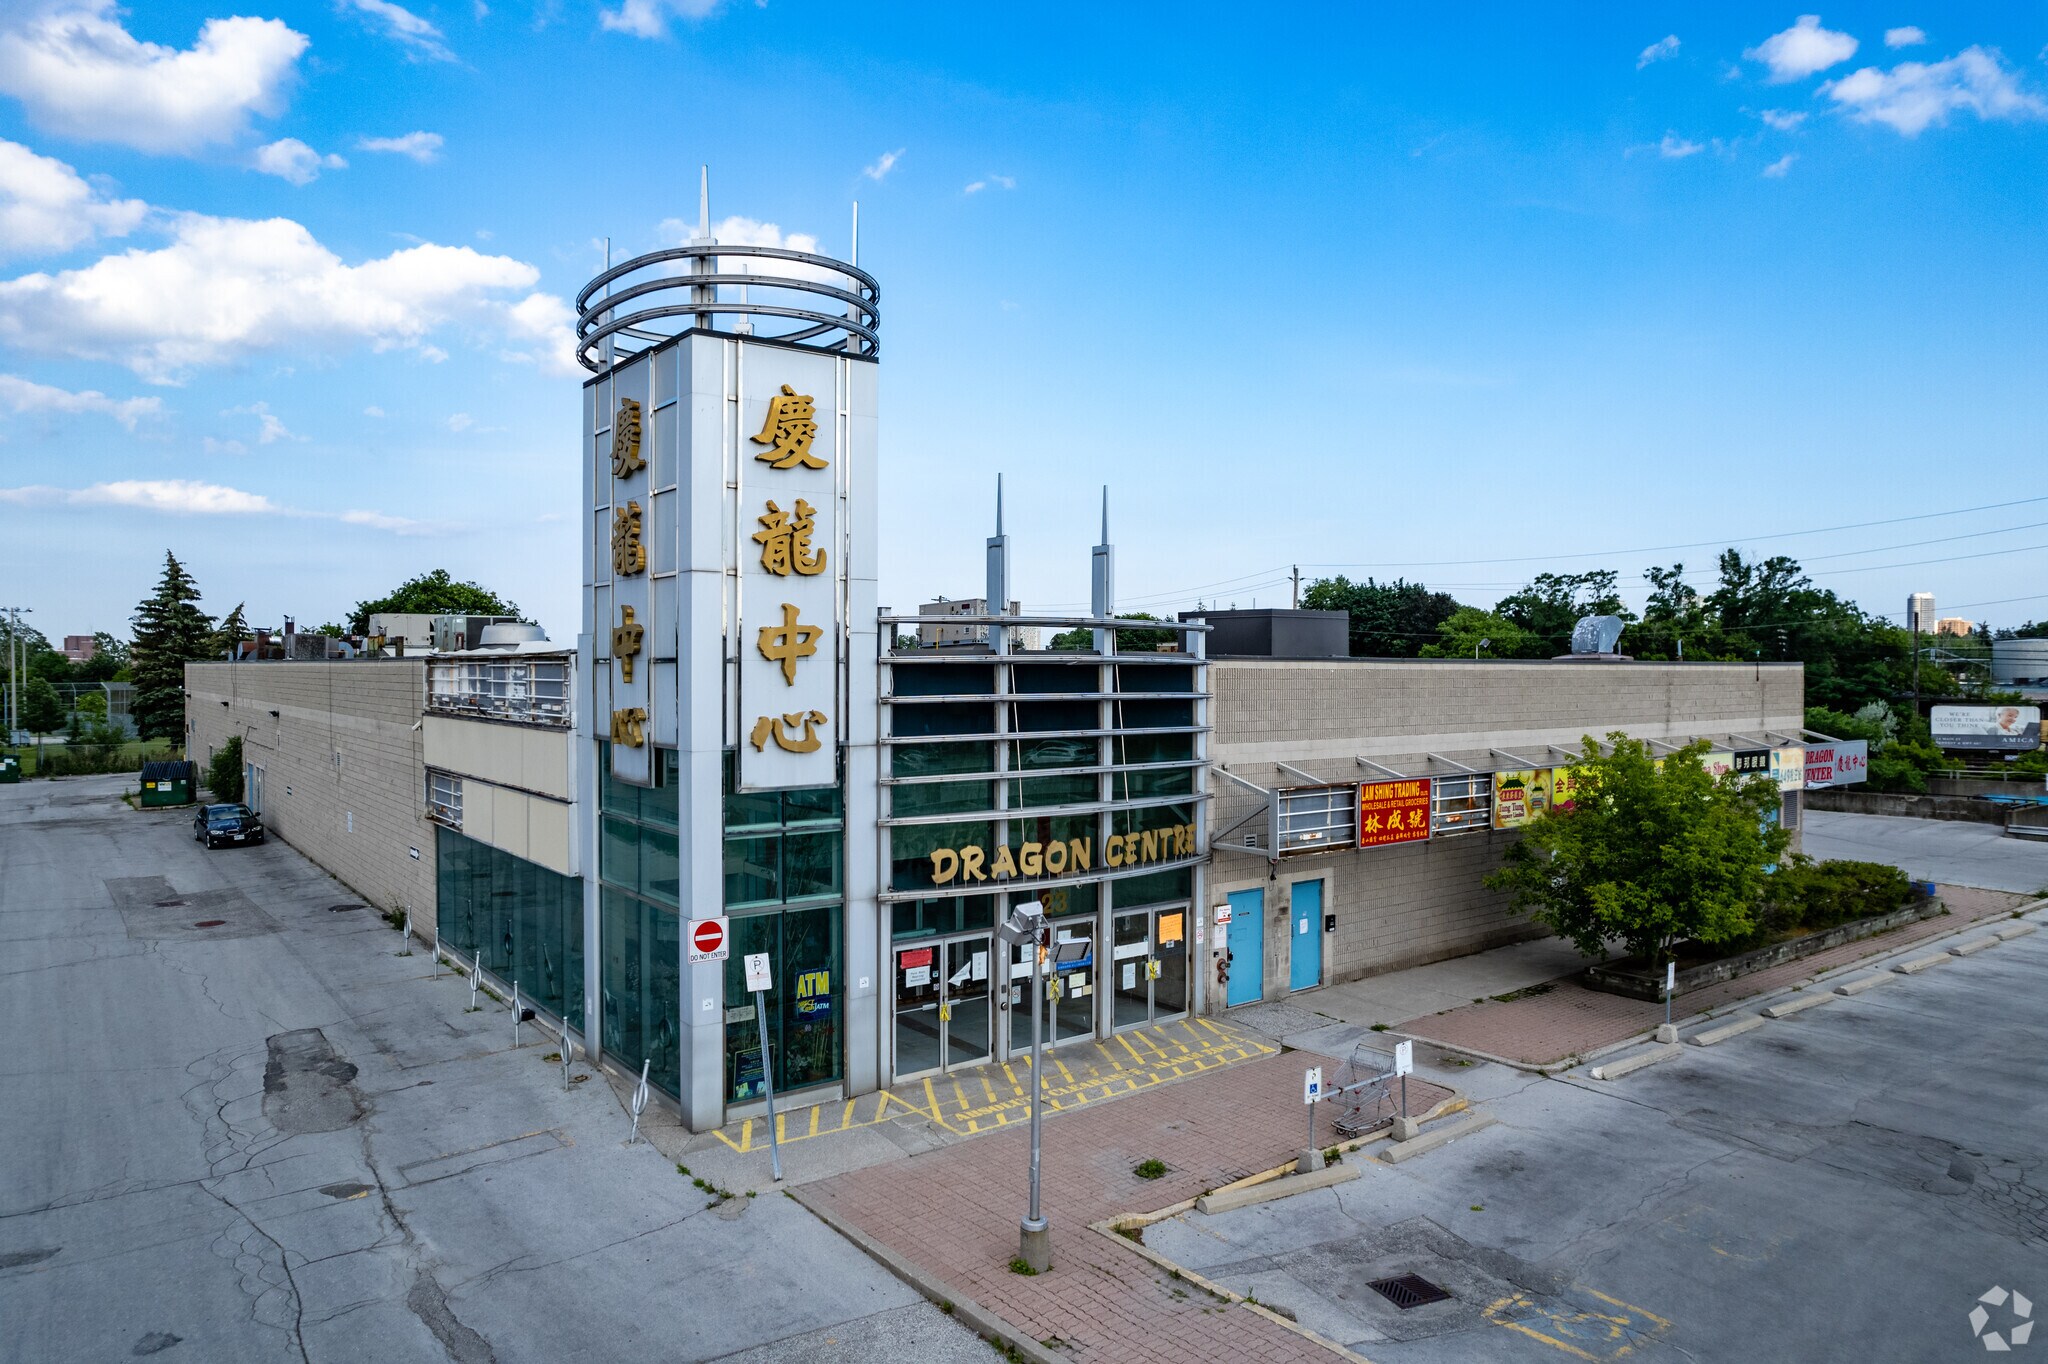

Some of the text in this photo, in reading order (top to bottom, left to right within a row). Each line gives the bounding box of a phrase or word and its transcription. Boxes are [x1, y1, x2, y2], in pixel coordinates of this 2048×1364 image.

[610, 398, 648, 748] 慶龍中心
[750, 384, 829, 753] 慶龍中心
[1805, 749, 1835, 765] DRAGON
[1804, 766, 1833, 781] ENTER
[1361, 785, 1374, 801] LAM
[1375, 783, 1393, 800] SHING
[1394, 781, 1420, 798] TRADING
[1361, 802, 1387, 811] WHOLESALE
[1391, 800, 1405, 808] RETAIL
[1405, 797, 1429, 807] GROCERIES
[1365, 808, 1426, 834] 林成號
[1106, 823, 1197, 867] CENTRE
[930, 837, 1091, 884] DRAGON
[1041, 892, 1068, 914] 23
[797, 971, 830, 999] ATM
